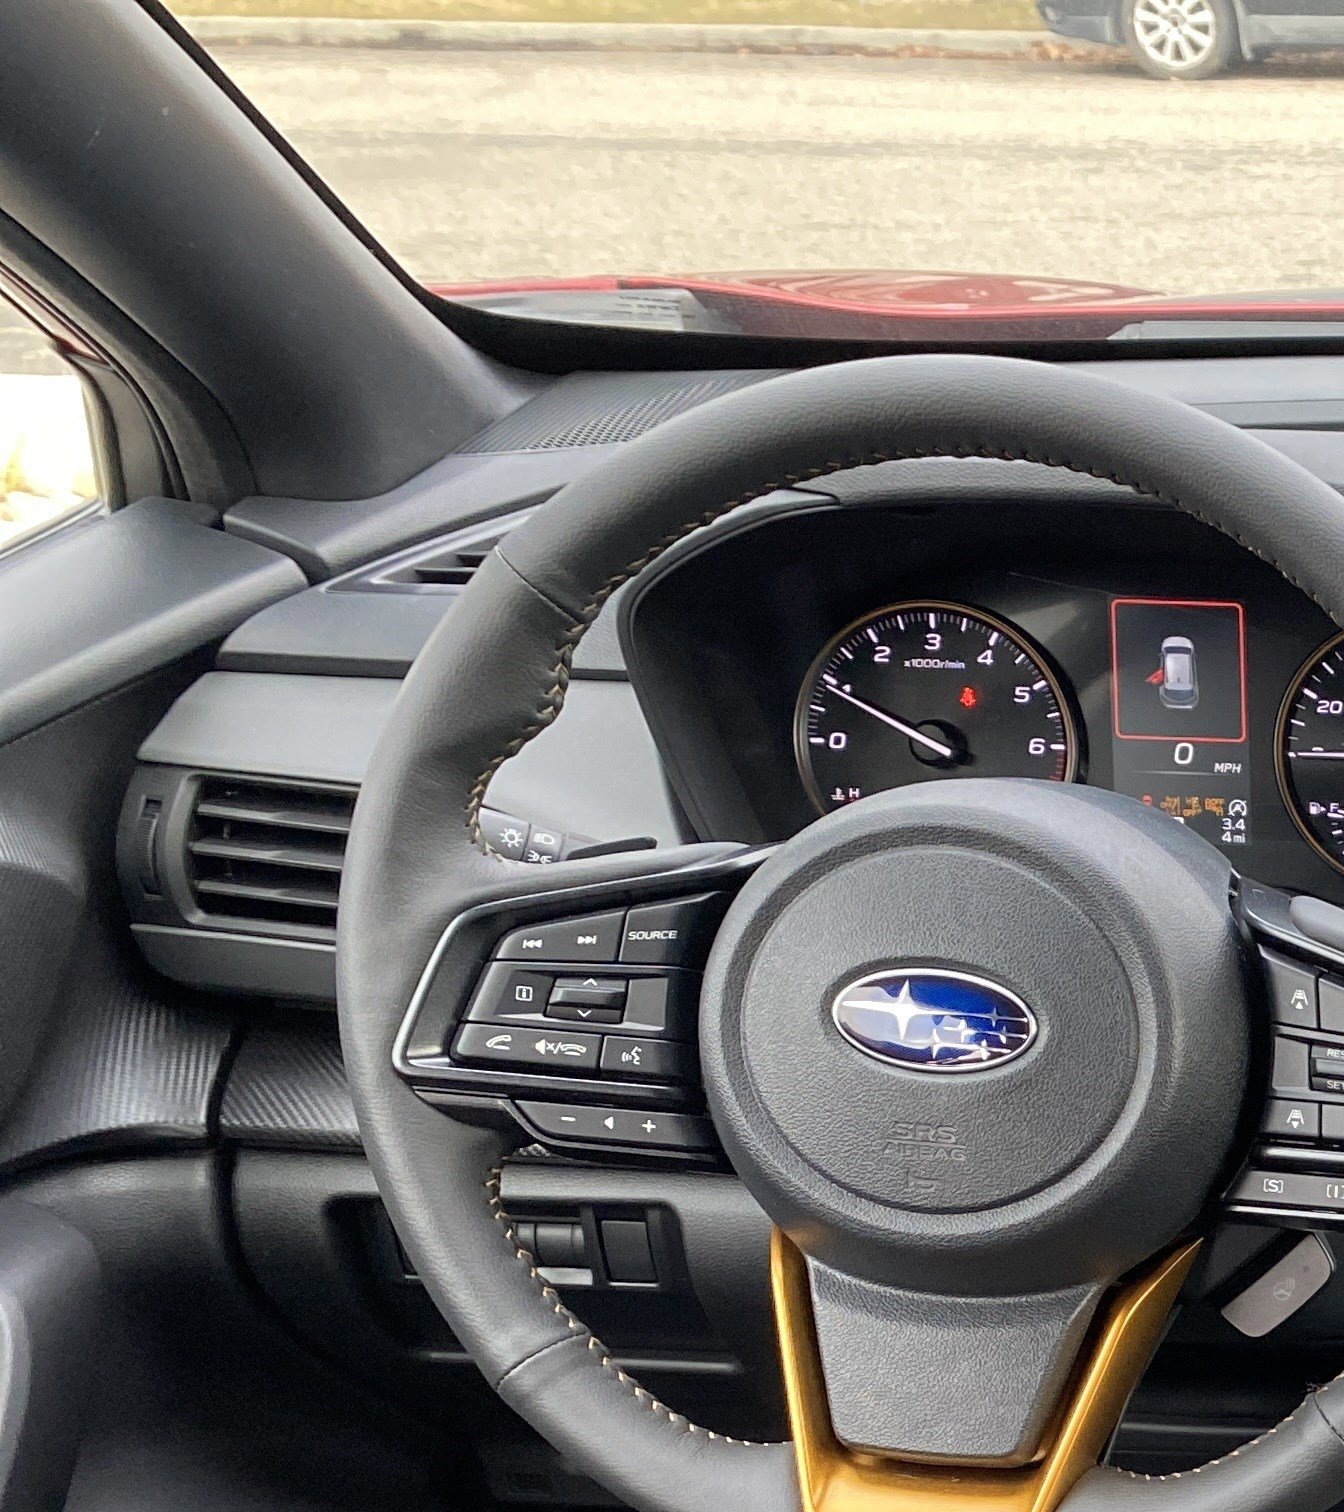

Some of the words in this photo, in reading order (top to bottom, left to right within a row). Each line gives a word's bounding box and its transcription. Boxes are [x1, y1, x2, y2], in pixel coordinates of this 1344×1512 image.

[924, 633, 941, 650] 3
[873, 646, 891, 662] 2
[977, 649, 994, 665] 4
[1014, 686, 1031, 703] 5
[1317, 701, 1343, 714] 20
[829, 732, 846, 749] 0
[1028, 738, 1045, 754] 6
[1174, 742, 1194, 764] 0
[1214, 763, 1242, 773] MPH
[849, 787, 859, 798] H
[1330, 803, 1339, 811] F
[1222, 818, 1245, 830] 3.4
[1222, 832, 1231, 842] 4
[1233, 833, 1245, 843] mi
[628, 929, 677, 941] SOURCE
